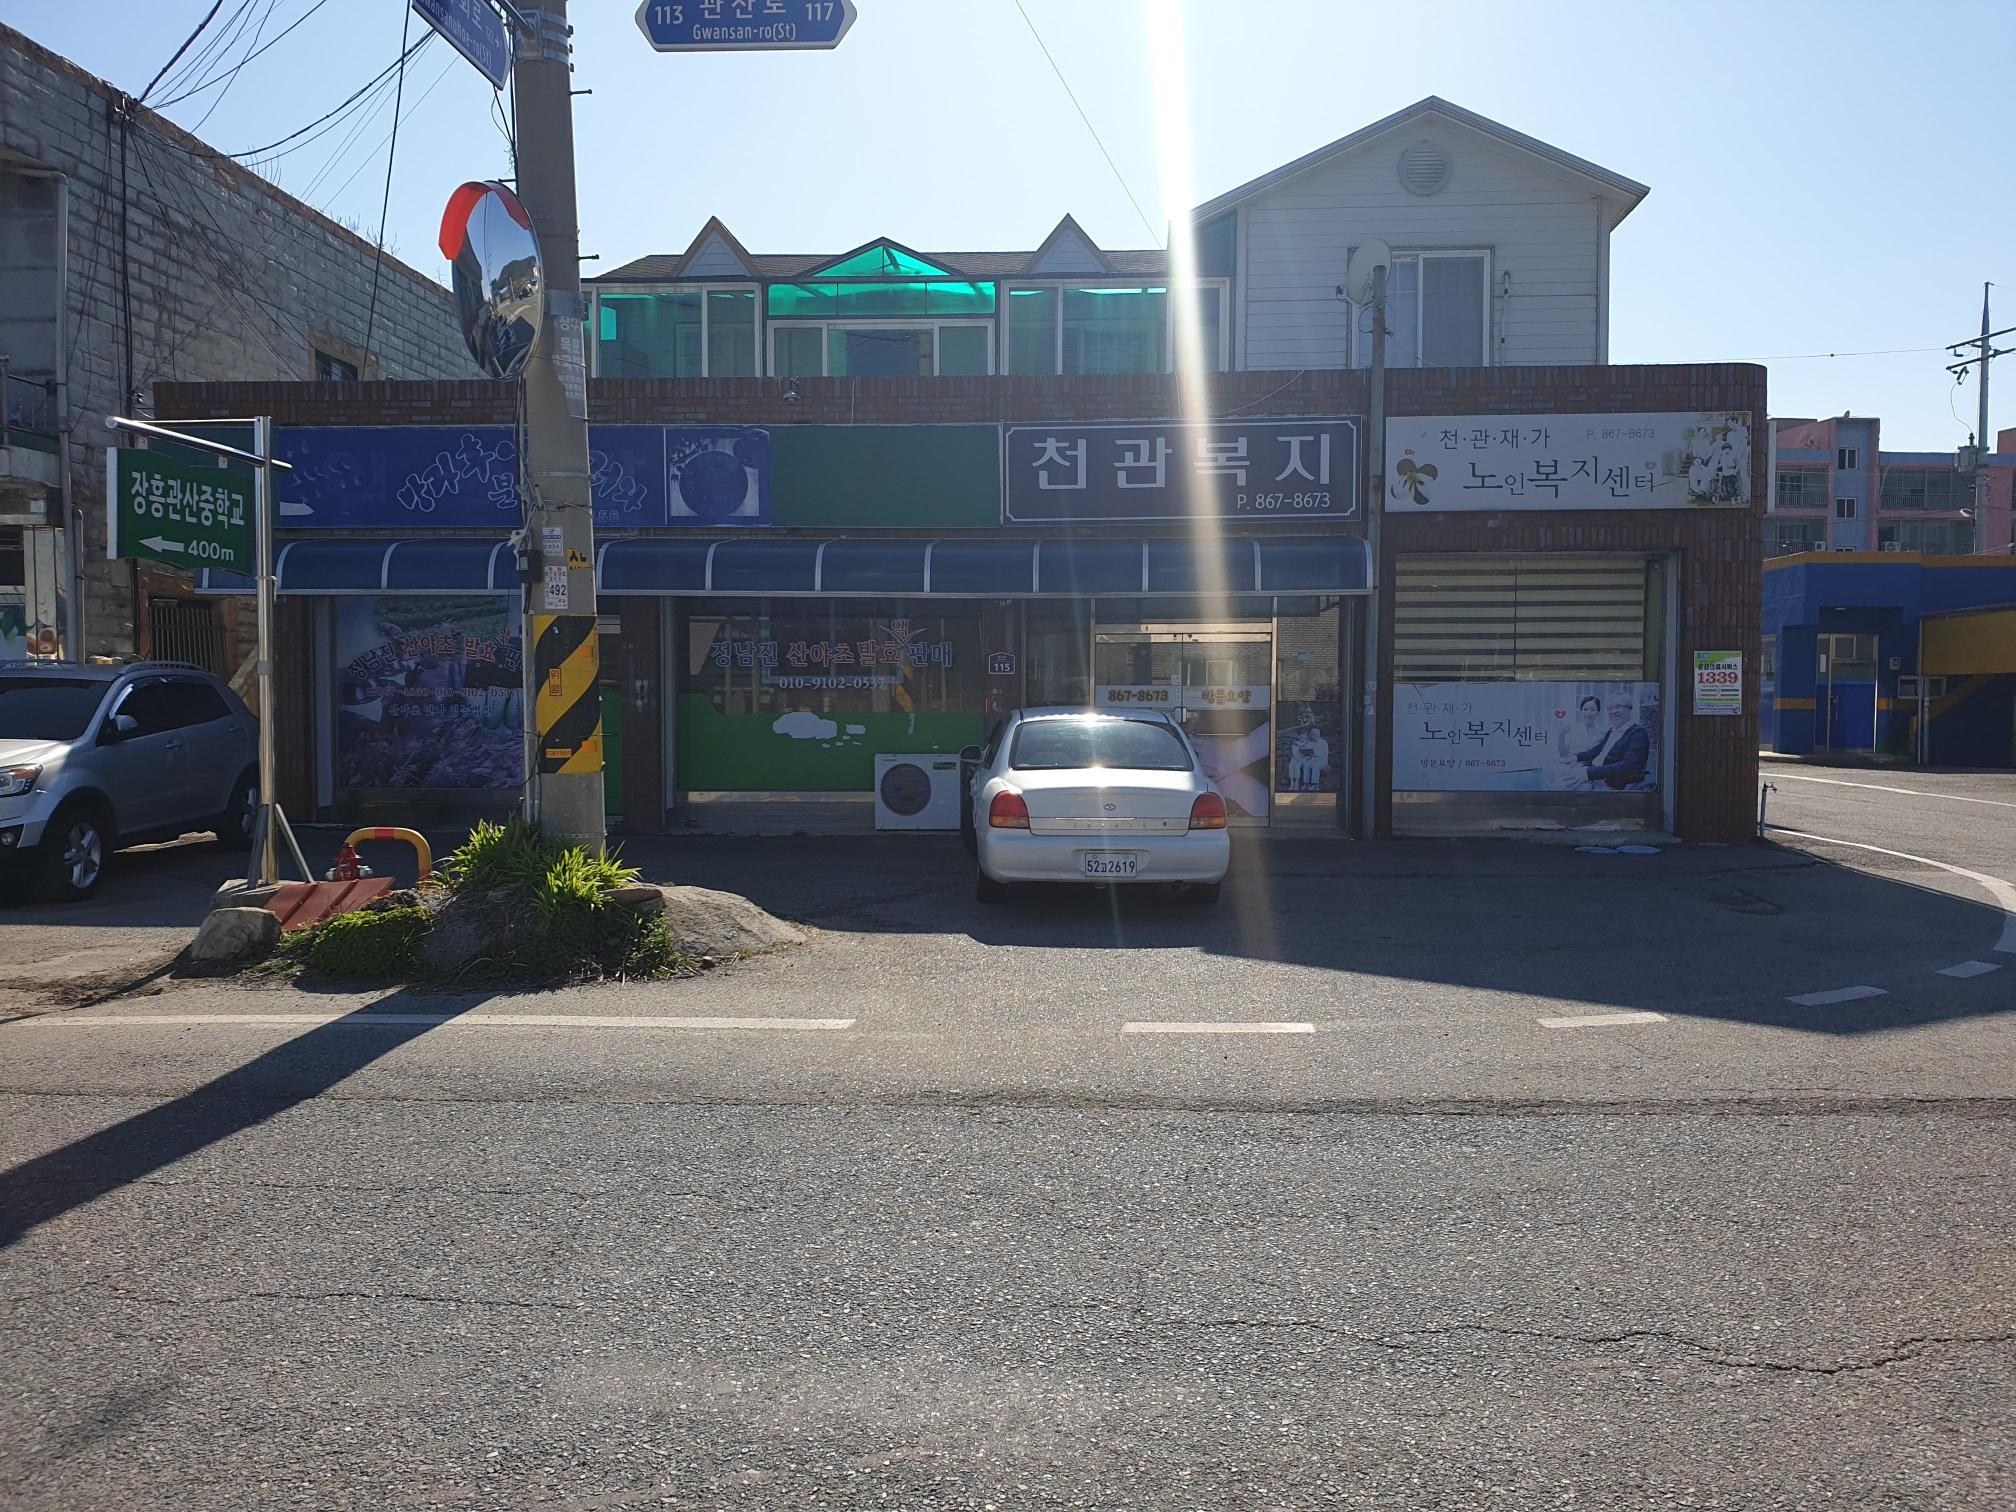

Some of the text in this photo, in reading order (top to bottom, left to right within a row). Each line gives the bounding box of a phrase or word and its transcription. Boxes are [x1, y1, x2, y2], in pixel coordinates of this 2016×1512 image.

[655, 6, 683, 24] 113
[805, 3, 834, 21] 117
[693, 22, 796, 40] Gwansan-ro(St)
[1601, 427, 1655, 439] 867-8673
[1032, 434, 1330, 490] 천관복지
[1462, 456, 1655, 499] 노인복지센터
[131, 471, 245, 530] 장흥관산중학교
[1237, 492, 1330, 510] P. 867-8673
[188, 540, 235, 562] 400m
[549, 584, 567, 596] 492
[891, 619, 909, 637] 액
[348, 634, 524, 680] 정남진 산야초 발효 판
[711, 641, 778, 667] 정남진
[786, 641, 854, 668] 산야초
[907, 642, 953, 667] 판매
[994, 663, 1010, 672] 115
[779, 677, 886, 689] 010-9102-0537
[1697, 671, 1739, 684] 1339
[1108, 689, 1169, 702] 867-8673
[1420, 719, 1549, 747] 노인복지센터
[1465, 759, 1506, 768] 867-8673
[1087, 860, 1136, 873] 52고2619
